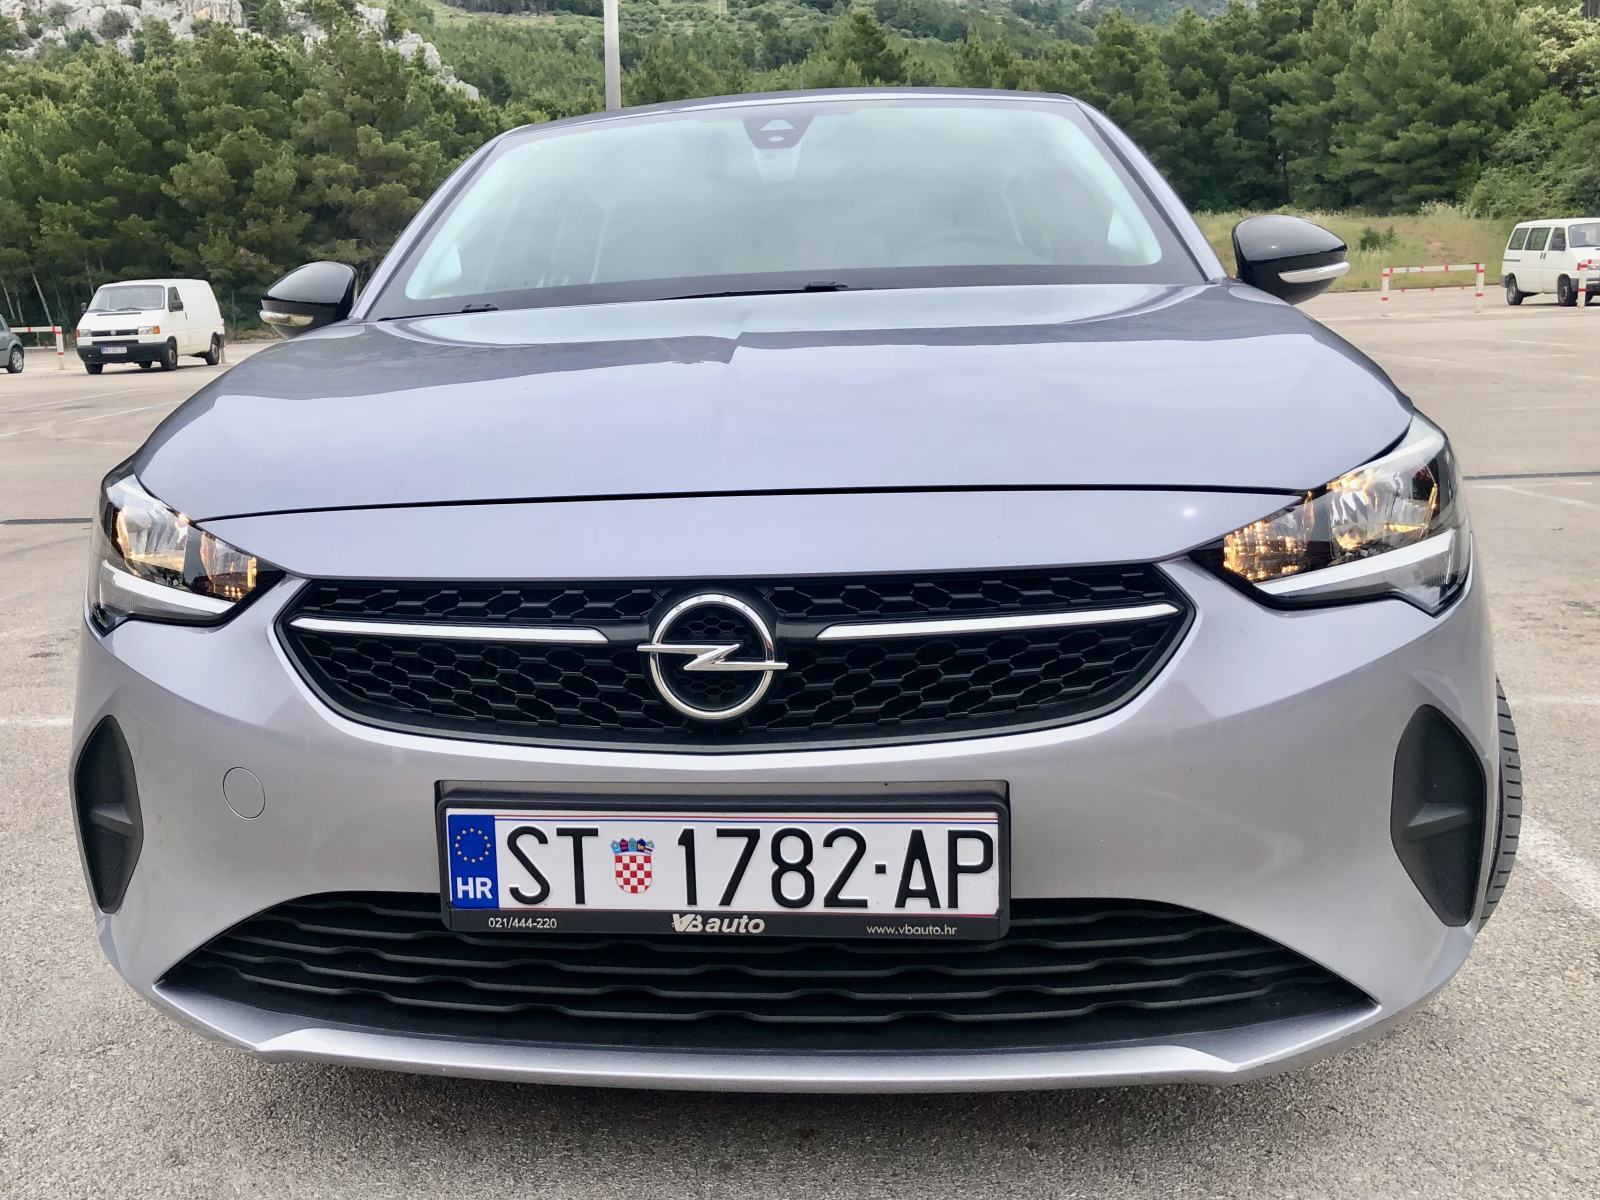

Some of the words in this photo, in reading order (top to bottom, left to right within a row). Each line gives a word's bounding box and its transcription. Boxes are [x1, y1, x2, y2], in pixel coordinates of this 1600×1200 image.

[507, 826, 599, 905] ST
[457, 876, 493, 899] HR
[488, 917, 558, 929] 021/444-220
[866, 924, 957, 935] www.vbauto.hr
